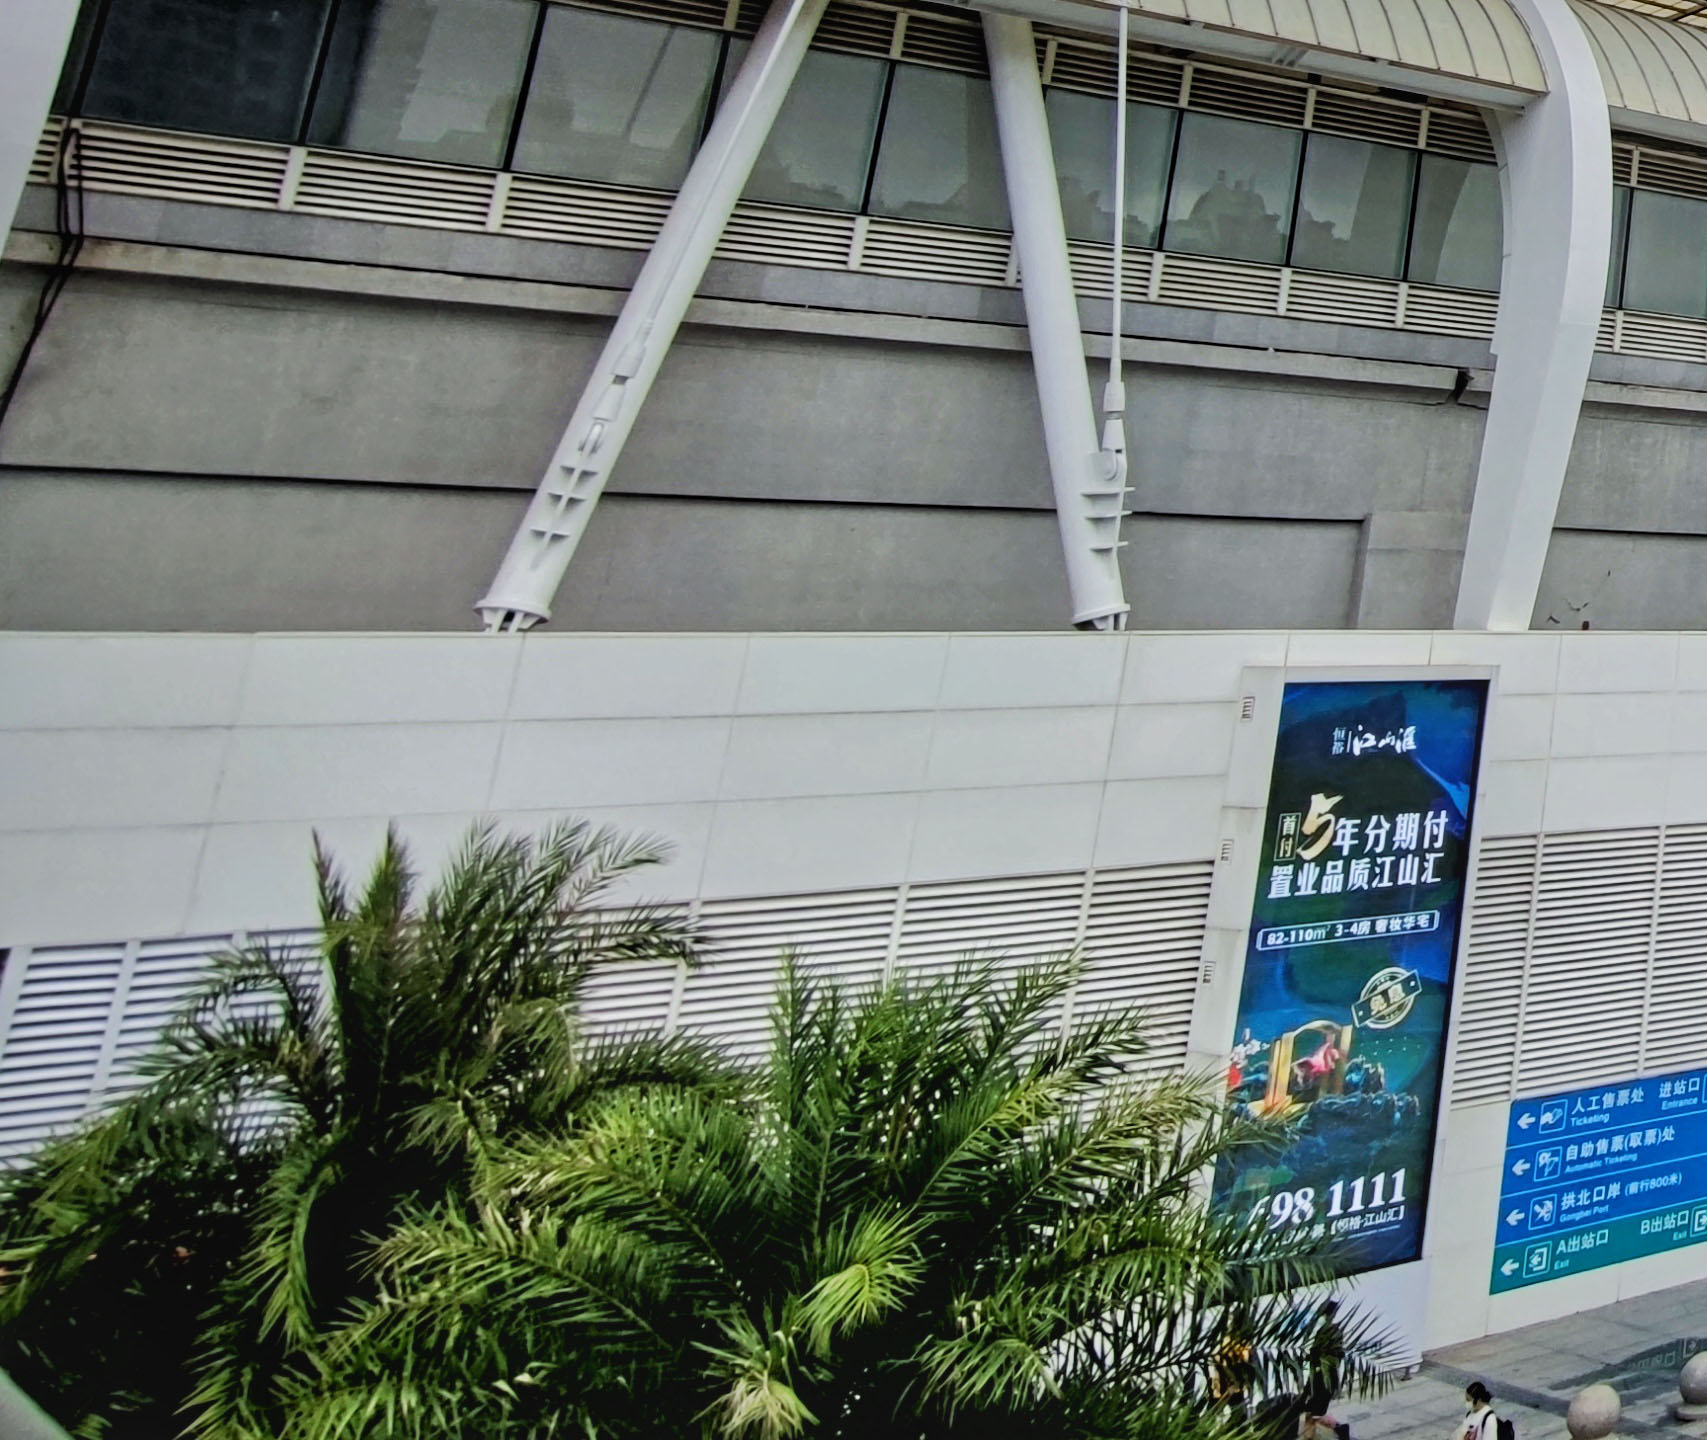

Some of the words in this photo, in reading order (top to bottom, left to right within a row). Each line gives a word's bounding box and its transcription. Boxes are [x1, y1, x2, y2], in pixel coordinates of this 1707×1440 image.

[1267, 853, 1445, 899] 置业品质江山汇
[1572, 1087, 1644, 1115] 人工售票处
[1659, 1077, 1700, 1099] 进站口
[1661, 1096, 1698, 1110] Entrance
[1571, 1112, 1610, 1127] Ticketing
[1326, 1168, 1406, 1217] 1111
[1561, 1181, 1621, 1210] 拱北口岸
[1640, 1210, 1689, 1235] B出站口
[1556, 1229, 1609, 1255] A出站口
